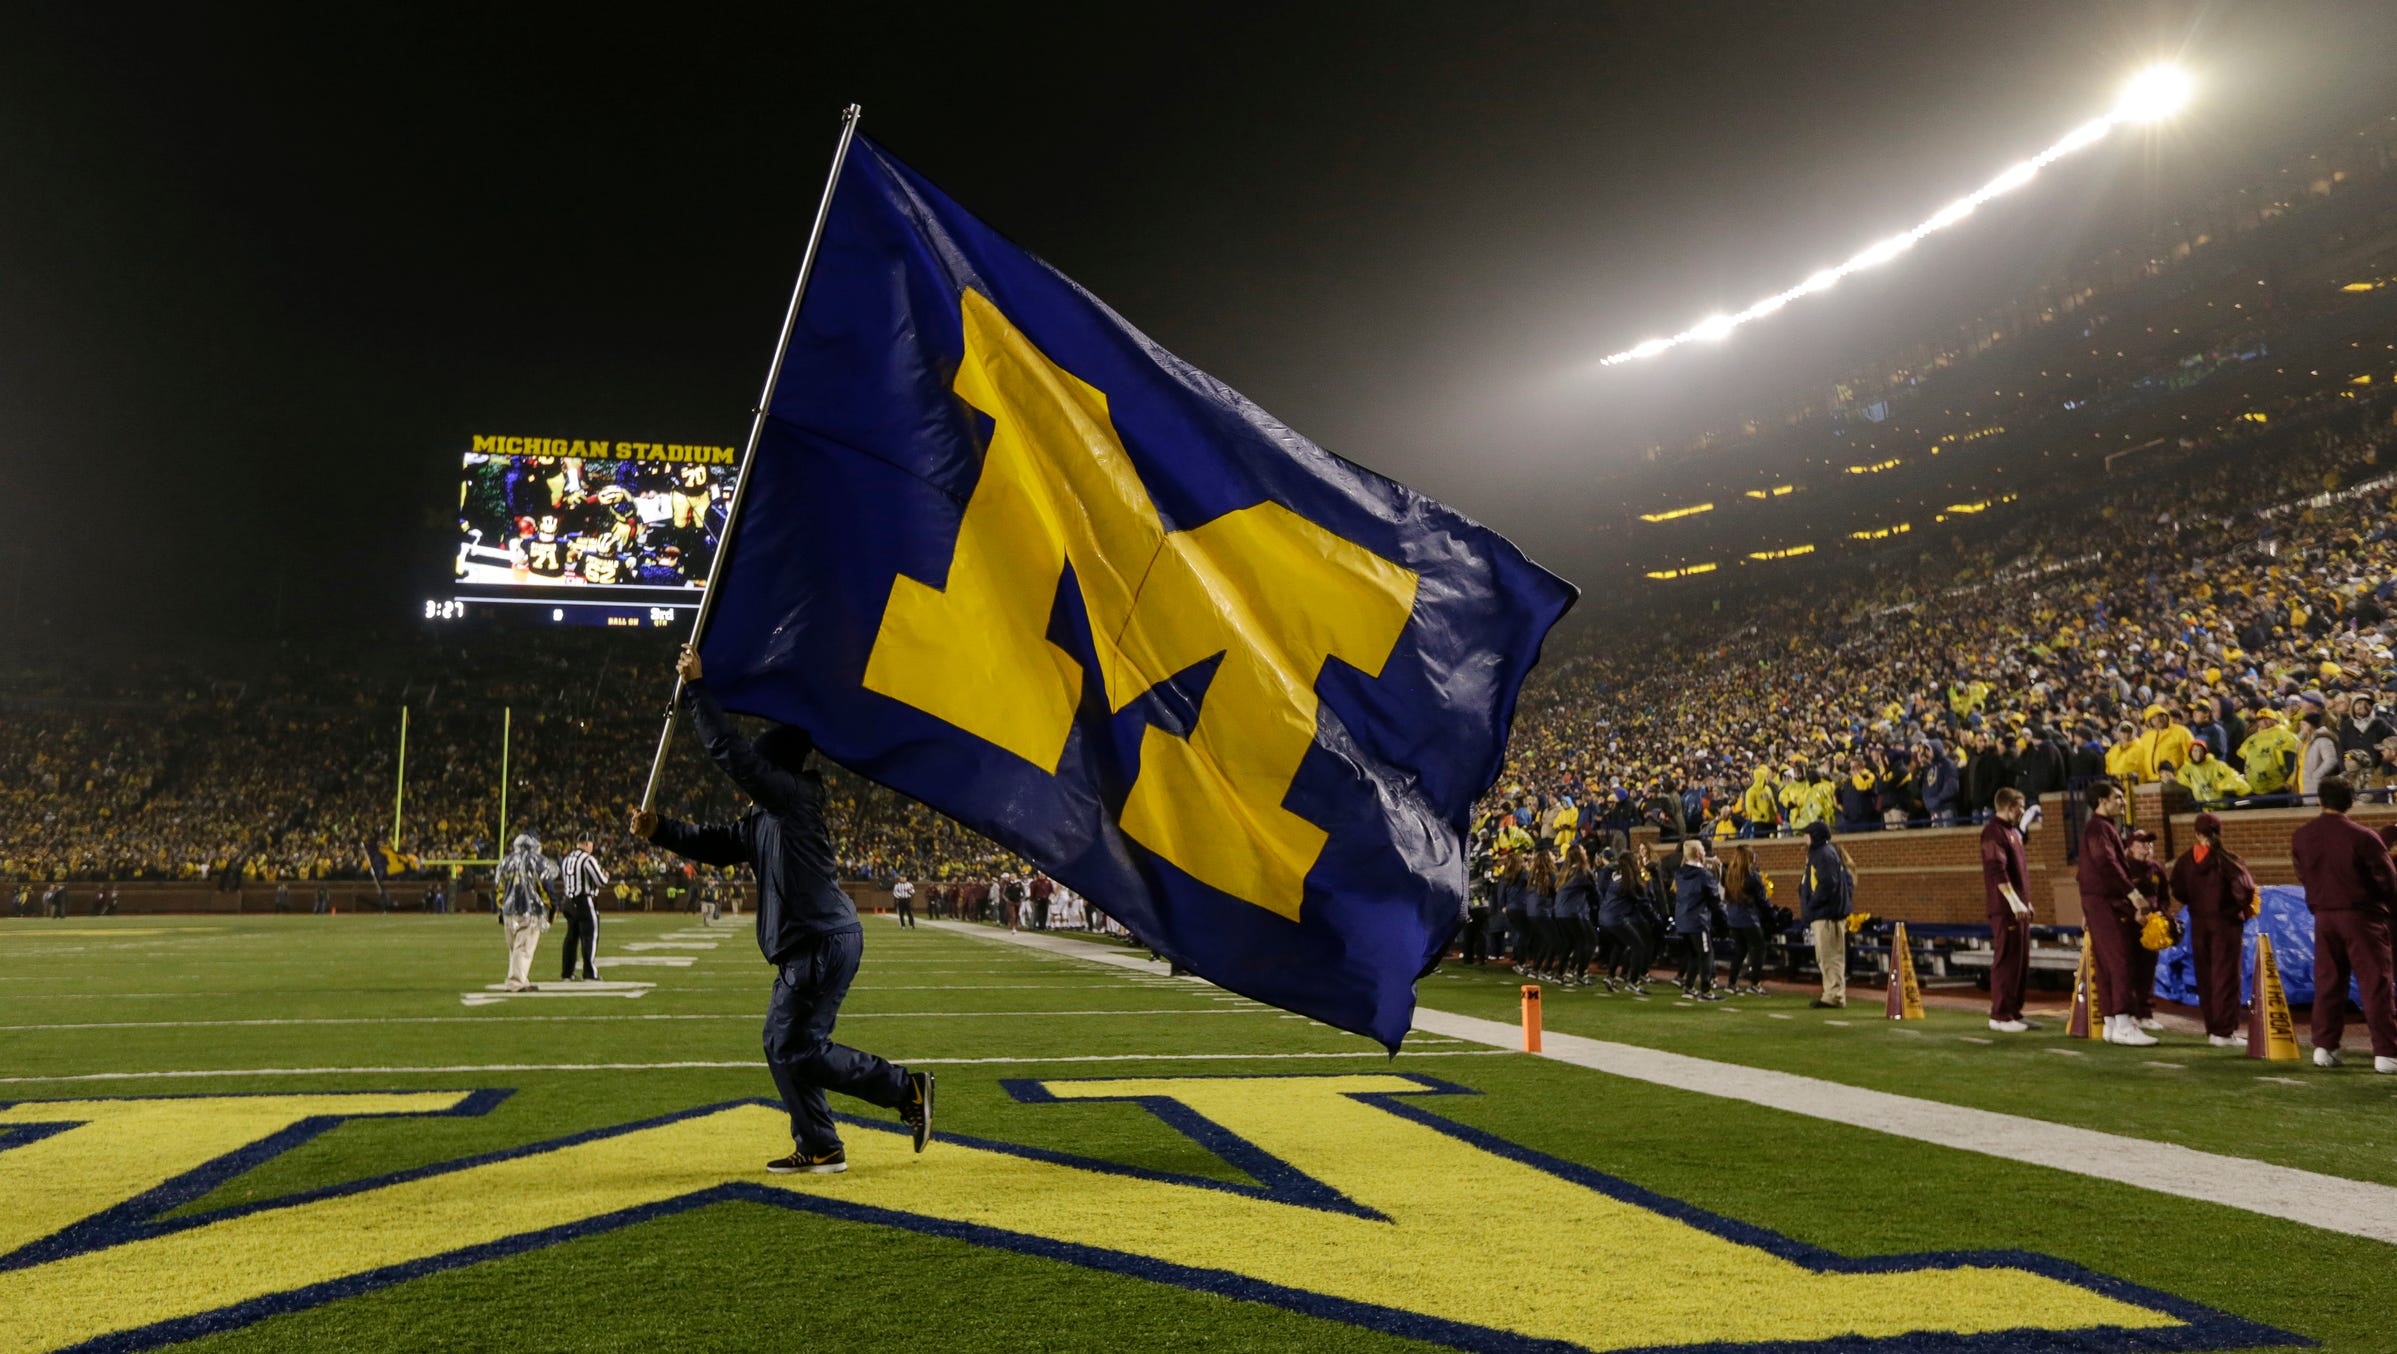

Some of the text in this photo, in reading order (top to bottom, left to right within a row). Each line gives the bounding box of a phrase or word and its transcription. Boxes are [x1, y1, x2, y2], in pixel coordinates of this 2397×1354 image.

[472, 433, 735, 465] MICHIGAN STADIUM
[681, 464, 707, 488] 70
[530, 546, 559, 570] 71
[585, 562, 616, 584] 62
[425, 599, 464, 619] 3:27
[650, 607, 674, 621] 3rd
[862, 286, 1418, 923] M
[2267, 984, 2286, 1009] THE
[2269, 1011, 2295, 1045] BOAT
